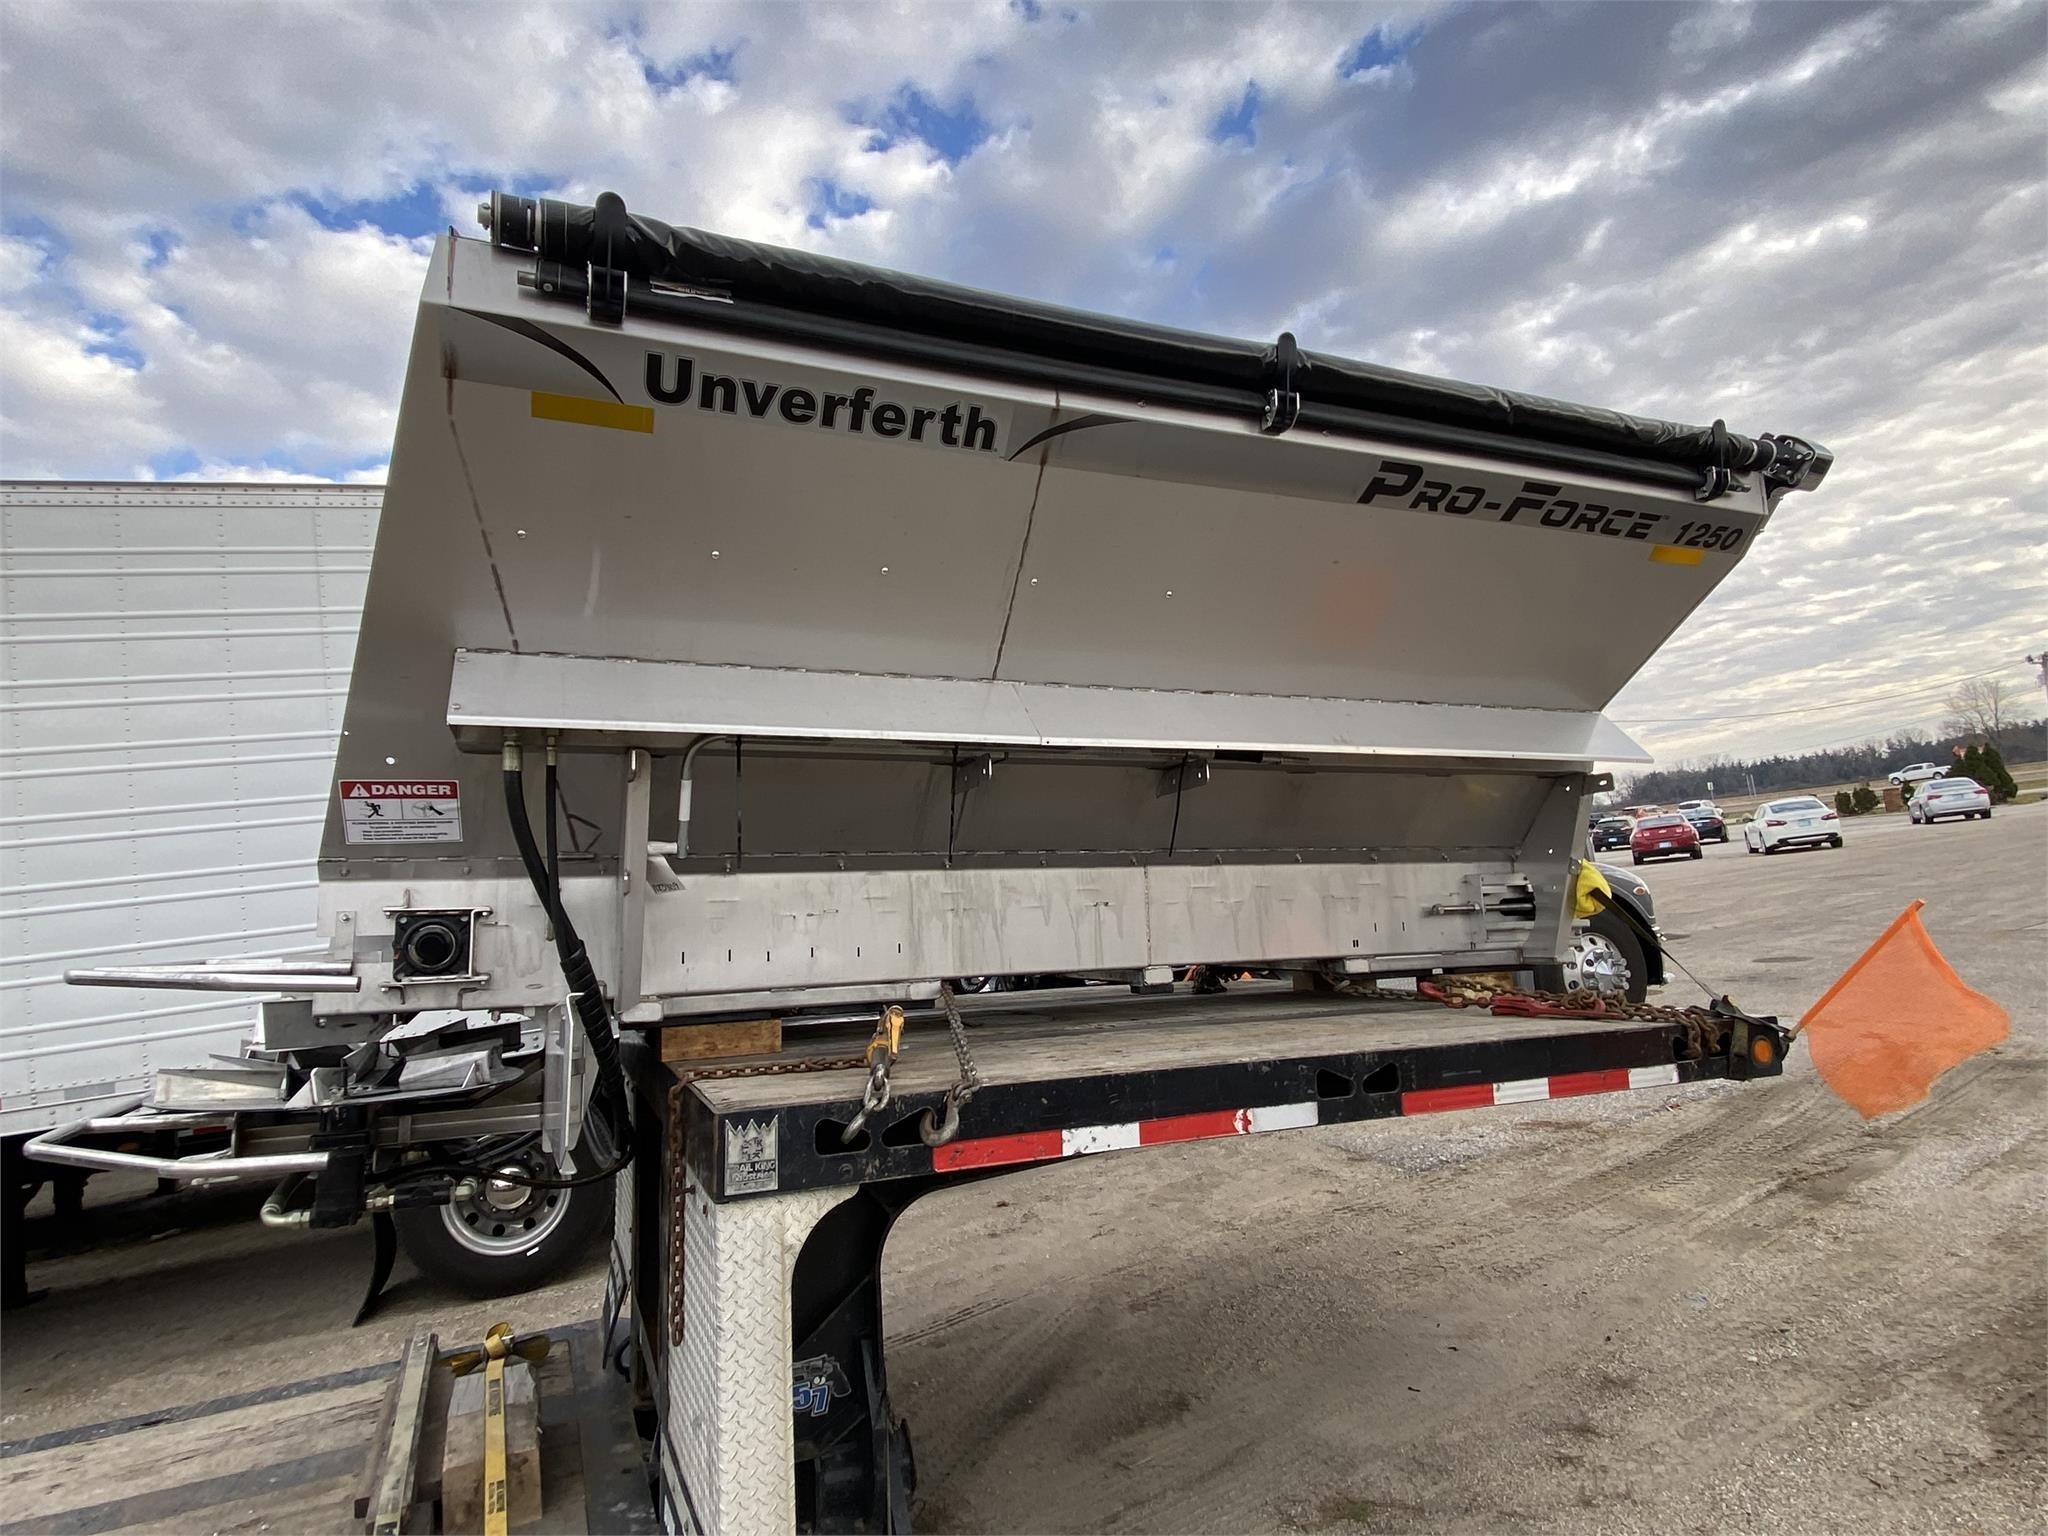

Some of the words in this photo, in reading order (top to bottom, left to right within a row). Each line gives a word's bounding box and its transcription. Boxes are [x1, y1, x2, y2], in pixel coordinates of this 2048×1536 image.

[645, 353, 996, 451] Unverferth
[1356, 460, 1661, 539] PRO-FORCE
[1673, 521, 1744, 551] 1250
[371, 784, 452, 796] DANGER
